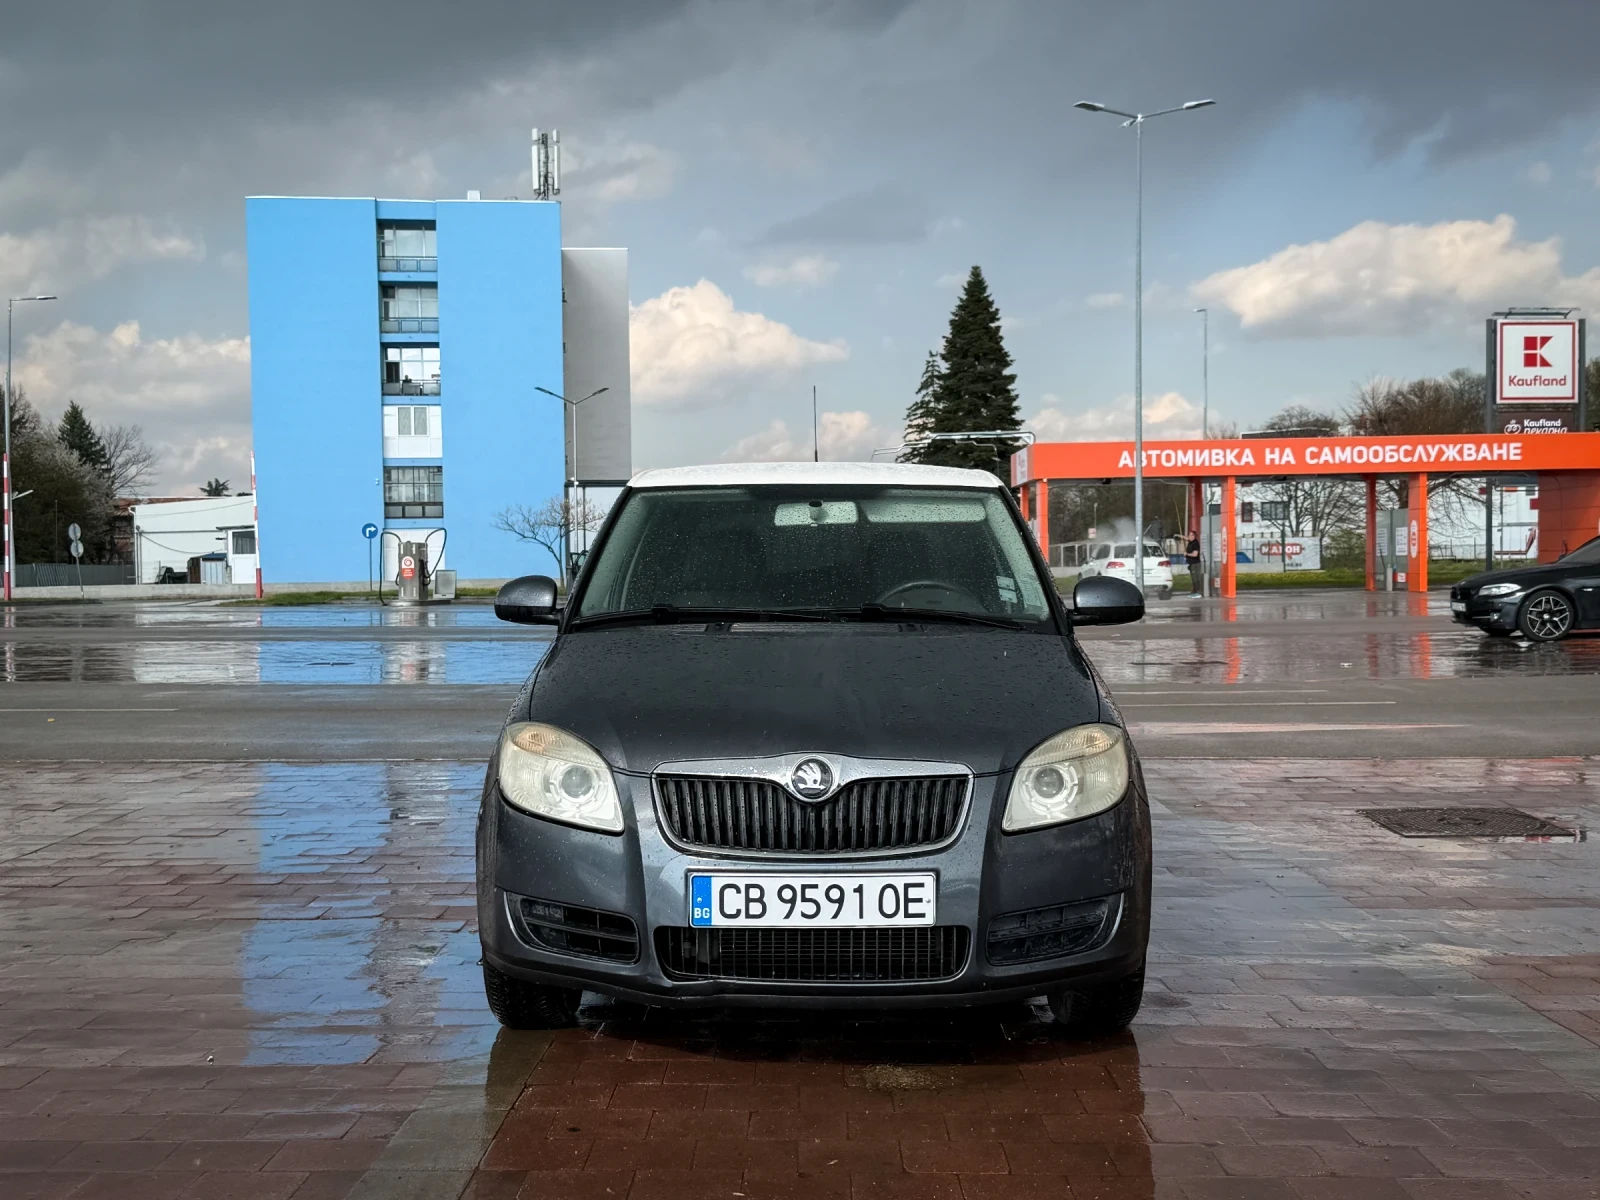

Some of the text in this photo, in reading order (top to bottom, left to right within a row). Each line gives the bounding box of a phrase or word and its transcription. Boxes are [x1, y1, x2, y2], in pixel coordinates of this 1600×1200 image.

[1508, 375, 1567, 387] Kaufland
[1523, 418, 1562, 427] Kaufland
[1264, 446, 1297, 466] НА
[1304, 442, 1523, 465] САМООБСЛУЖВАНЕ
[718, 883, 768, 919] CB
[776, 883, 864, 920] 9591
[694, 907, 711, 919] BG
